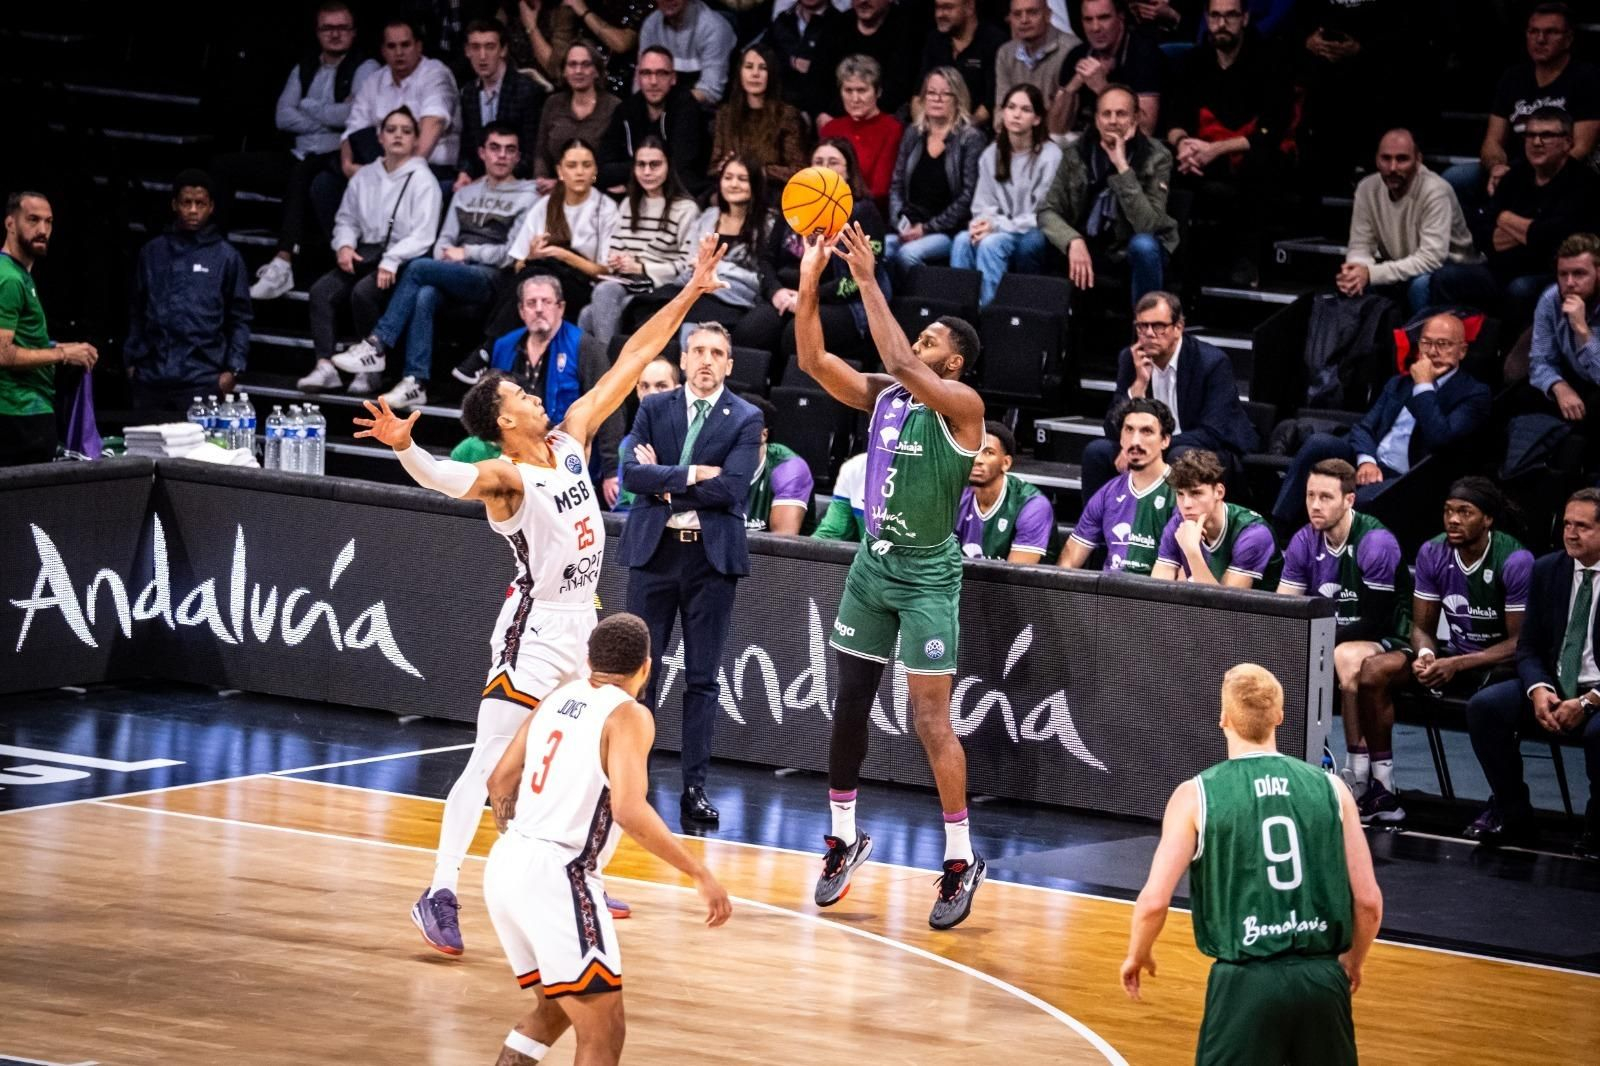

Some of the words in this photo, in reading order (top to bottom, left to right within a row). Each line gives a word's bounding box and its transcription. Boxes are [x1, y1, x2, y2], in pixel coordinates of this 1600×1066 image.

[1276, 248, 1287, 264] D
[1036, 428, 1047, 443] B
[554, 480, 590, 514] MSB
[881, 467, 898, 498] 3
[574, 516, 595, 551] 25
[9, 512, 425, 680] Andalucía
[1467, 605, 1498, 619] Unicaja
[530, 730, 563, 795] 3
[1254, 774, 1290, 798] DÍAZ
[1261, 815, 1303, 890] 9
